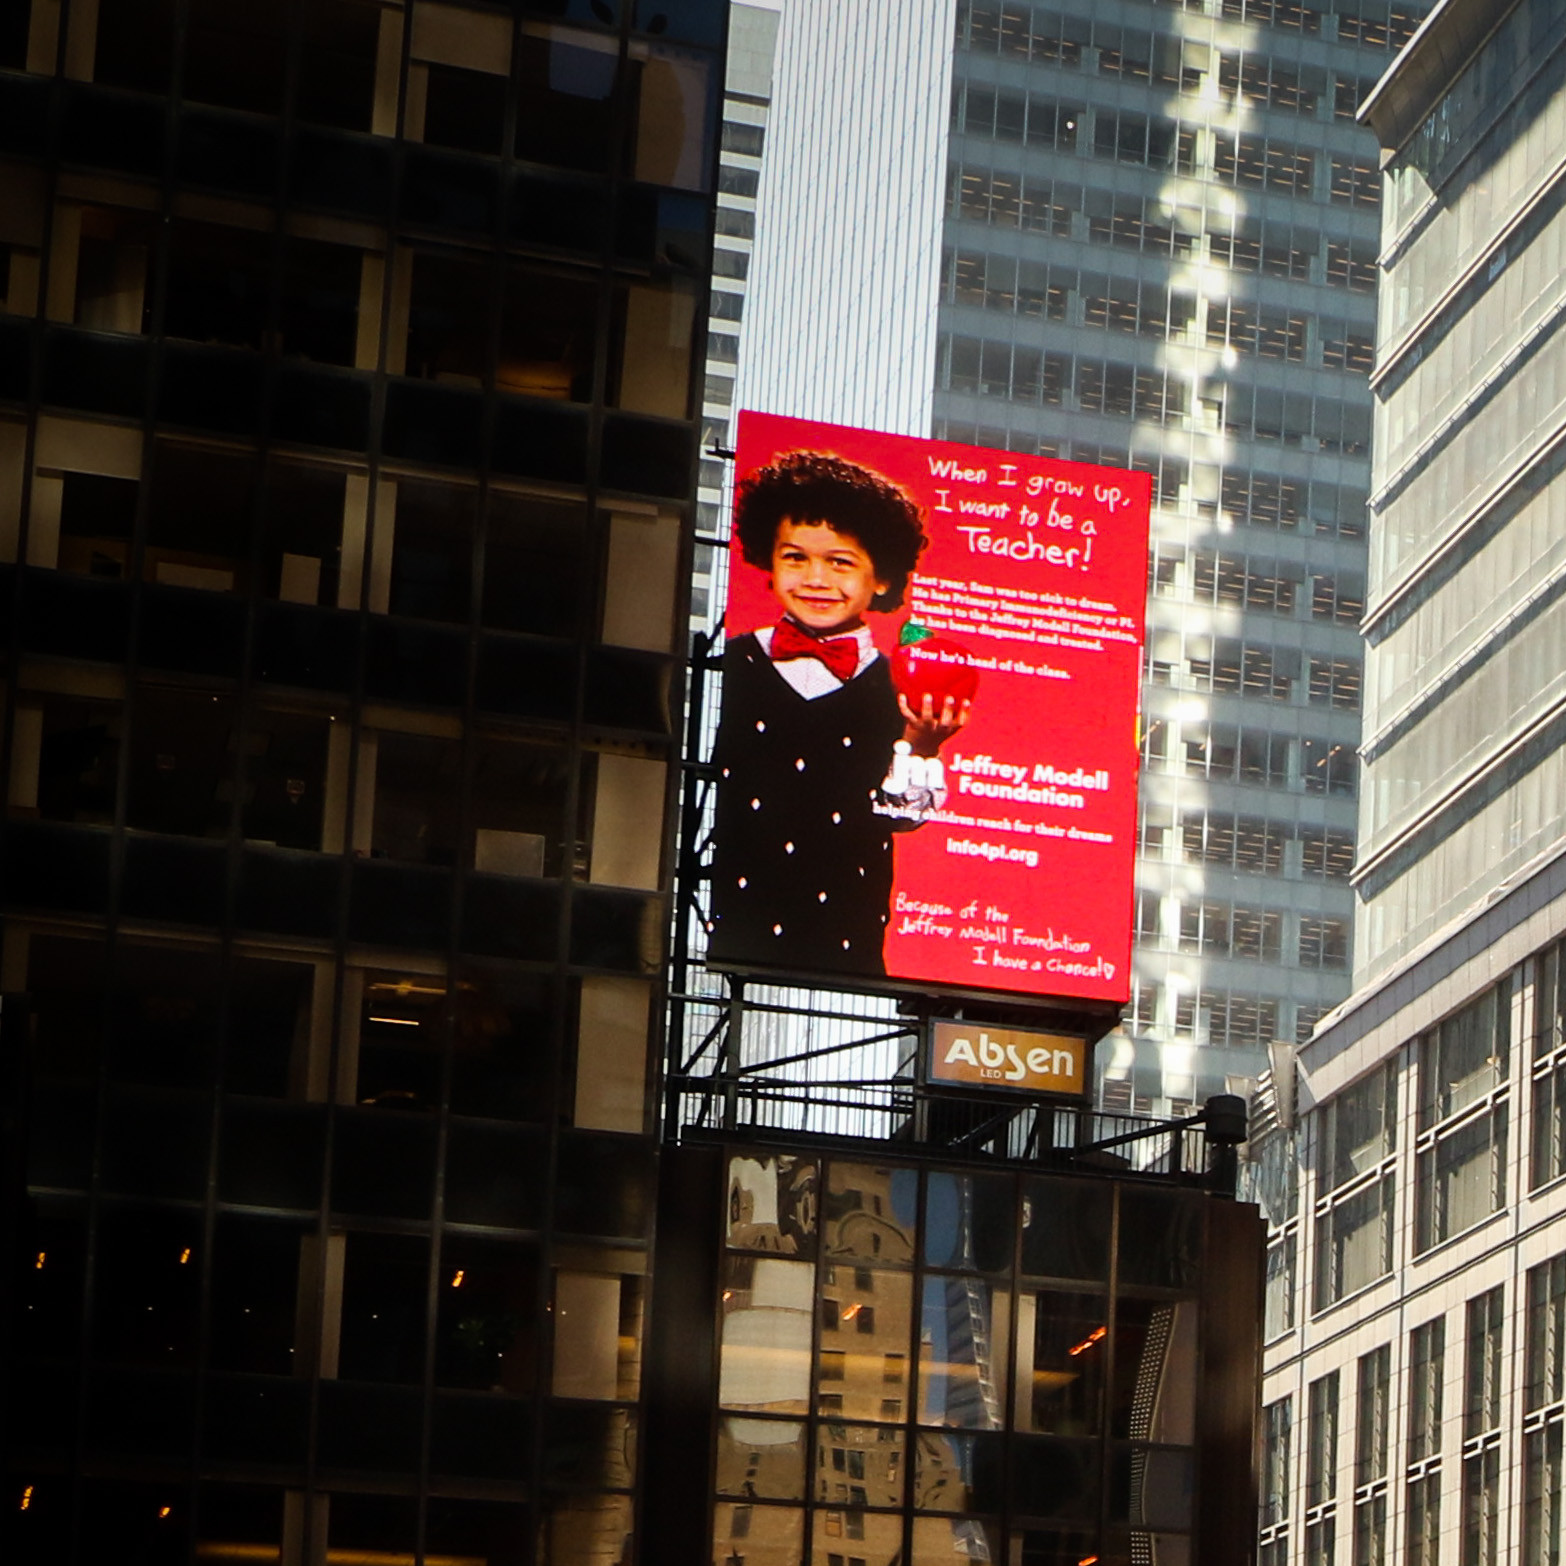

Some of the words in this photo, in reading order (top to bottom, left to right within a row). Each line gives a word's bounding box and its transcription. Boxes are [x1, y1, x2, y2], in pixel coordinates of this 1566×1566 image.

[928, 456, 987, 483] When
[998, 464, 1018, 486] I
[1026, 475, 1083, 497] grow
[1094, 485, 1130, 513] up,
[935, 489, 952, 512] I
[959, 500, 1011, 519] want
[1019, 505, 1039, 527] to
[1047, 498, 1073, 529] be
[1081, 520, 1097, 536] a
[957, 526, 1092, 571] Teacher!
[912, 573, 937, 586] Last
[939, 578, 968, 592] year,
[970, 582, 994, 594] Sam
[996, 586, 1017, 597] was
[1019, 590, 1038, 600] too
[1040, 592, 1063, 605] sick
[1065, 596, 1077, 606] to
[1079, 597, 1117, 612] dream.
[912, 587, 929, 599] He
[930, 590, 951, 601] has
[953, 593, 998, 611] Primary
[1000, 599, 1103, 626] Immunodeficiency
[1105, 616, 1118, 626] or
[912, 600, 953, 616] Thanks
[955, 607, 967, 618] to
[969, 608, 988, 621] the
[990, 611, 1030, 629] Jeffrey
[1032, 619, 1070, 635] Modell
[1072, 624, 1137, 644] Foundation,
[927, 617, 947, 628] has
[950, 620, 976, 633] been
[978, 624, 1035, 642] diagnosed
[1037, 633, 1058, 645] and
[1060, 637, 1103, 651] treated.
[910, 647, 938, 661] Now
[940, 649, 965, 664] he's
[966, 654, 997, 670] head
[998, 659, 1012, 672] of
[1013, 661, 1034, 675] the
[1036, 664, 1071, 679] class.
[882, 740, 944, 795] jm
[949, 754, 1027, 783] Jeffrey
[1033, 764, 1109, 790] Modell
[959, 776, 1084, 809] Foundation
[872, 801, 921, 821] helping
[922, 808, 975, 827] children
[977, 817, 1012, 831] reach
[1014, 821, 1033, 834] for
[1035, 823, 1066, 838] their
[1067, 827, 1113, 843] dreams
[896, 892, 952, 916] Because
[959, 900, 978, 920] of
[985, 905, 1009, 923] the
[898, 913, 953, 939] Jeffrey
[959, 926, 1006, 944] Modell
[1013, 927, 1091, 953] Foundation
[972, 946, 987, 965] I
[993, 950, 1027, 971] have
[1030, 960, 1041, 971] a
[1046, 956, 1102, 977] Chance!
[944, 1033, 1073, 1081] Absen
[980, 1068, 1001, 1079] LED
